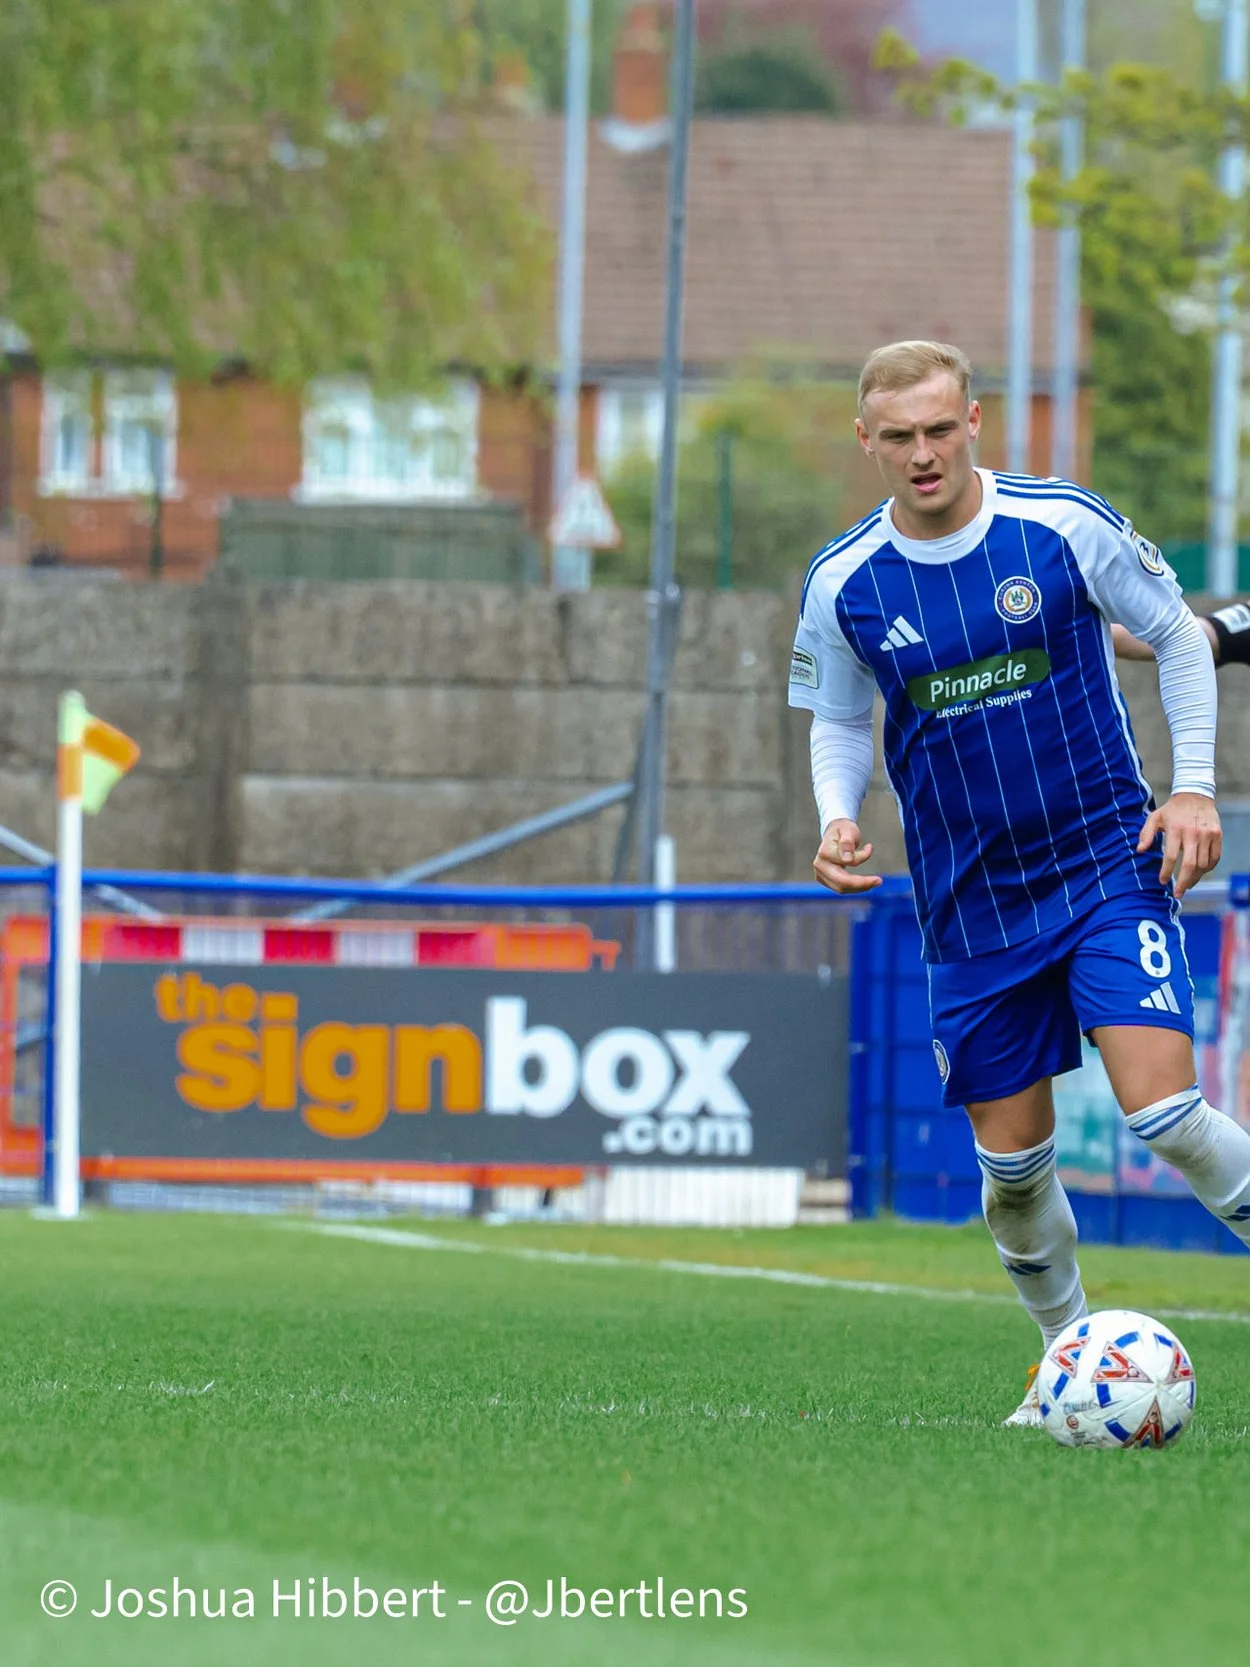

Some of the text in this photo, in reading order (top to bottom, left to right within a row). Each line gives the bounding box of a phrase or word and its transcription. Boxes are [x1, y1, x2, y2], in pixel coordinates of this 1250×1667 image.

[930, 660, 1027, 703] Pinnacle
[985, 689, 1032, 708] Supplies
[1137, 919, 1172, 978] 8
[154, 972, 256, 1022] the
[603, 1115, 752, 1155] .com
